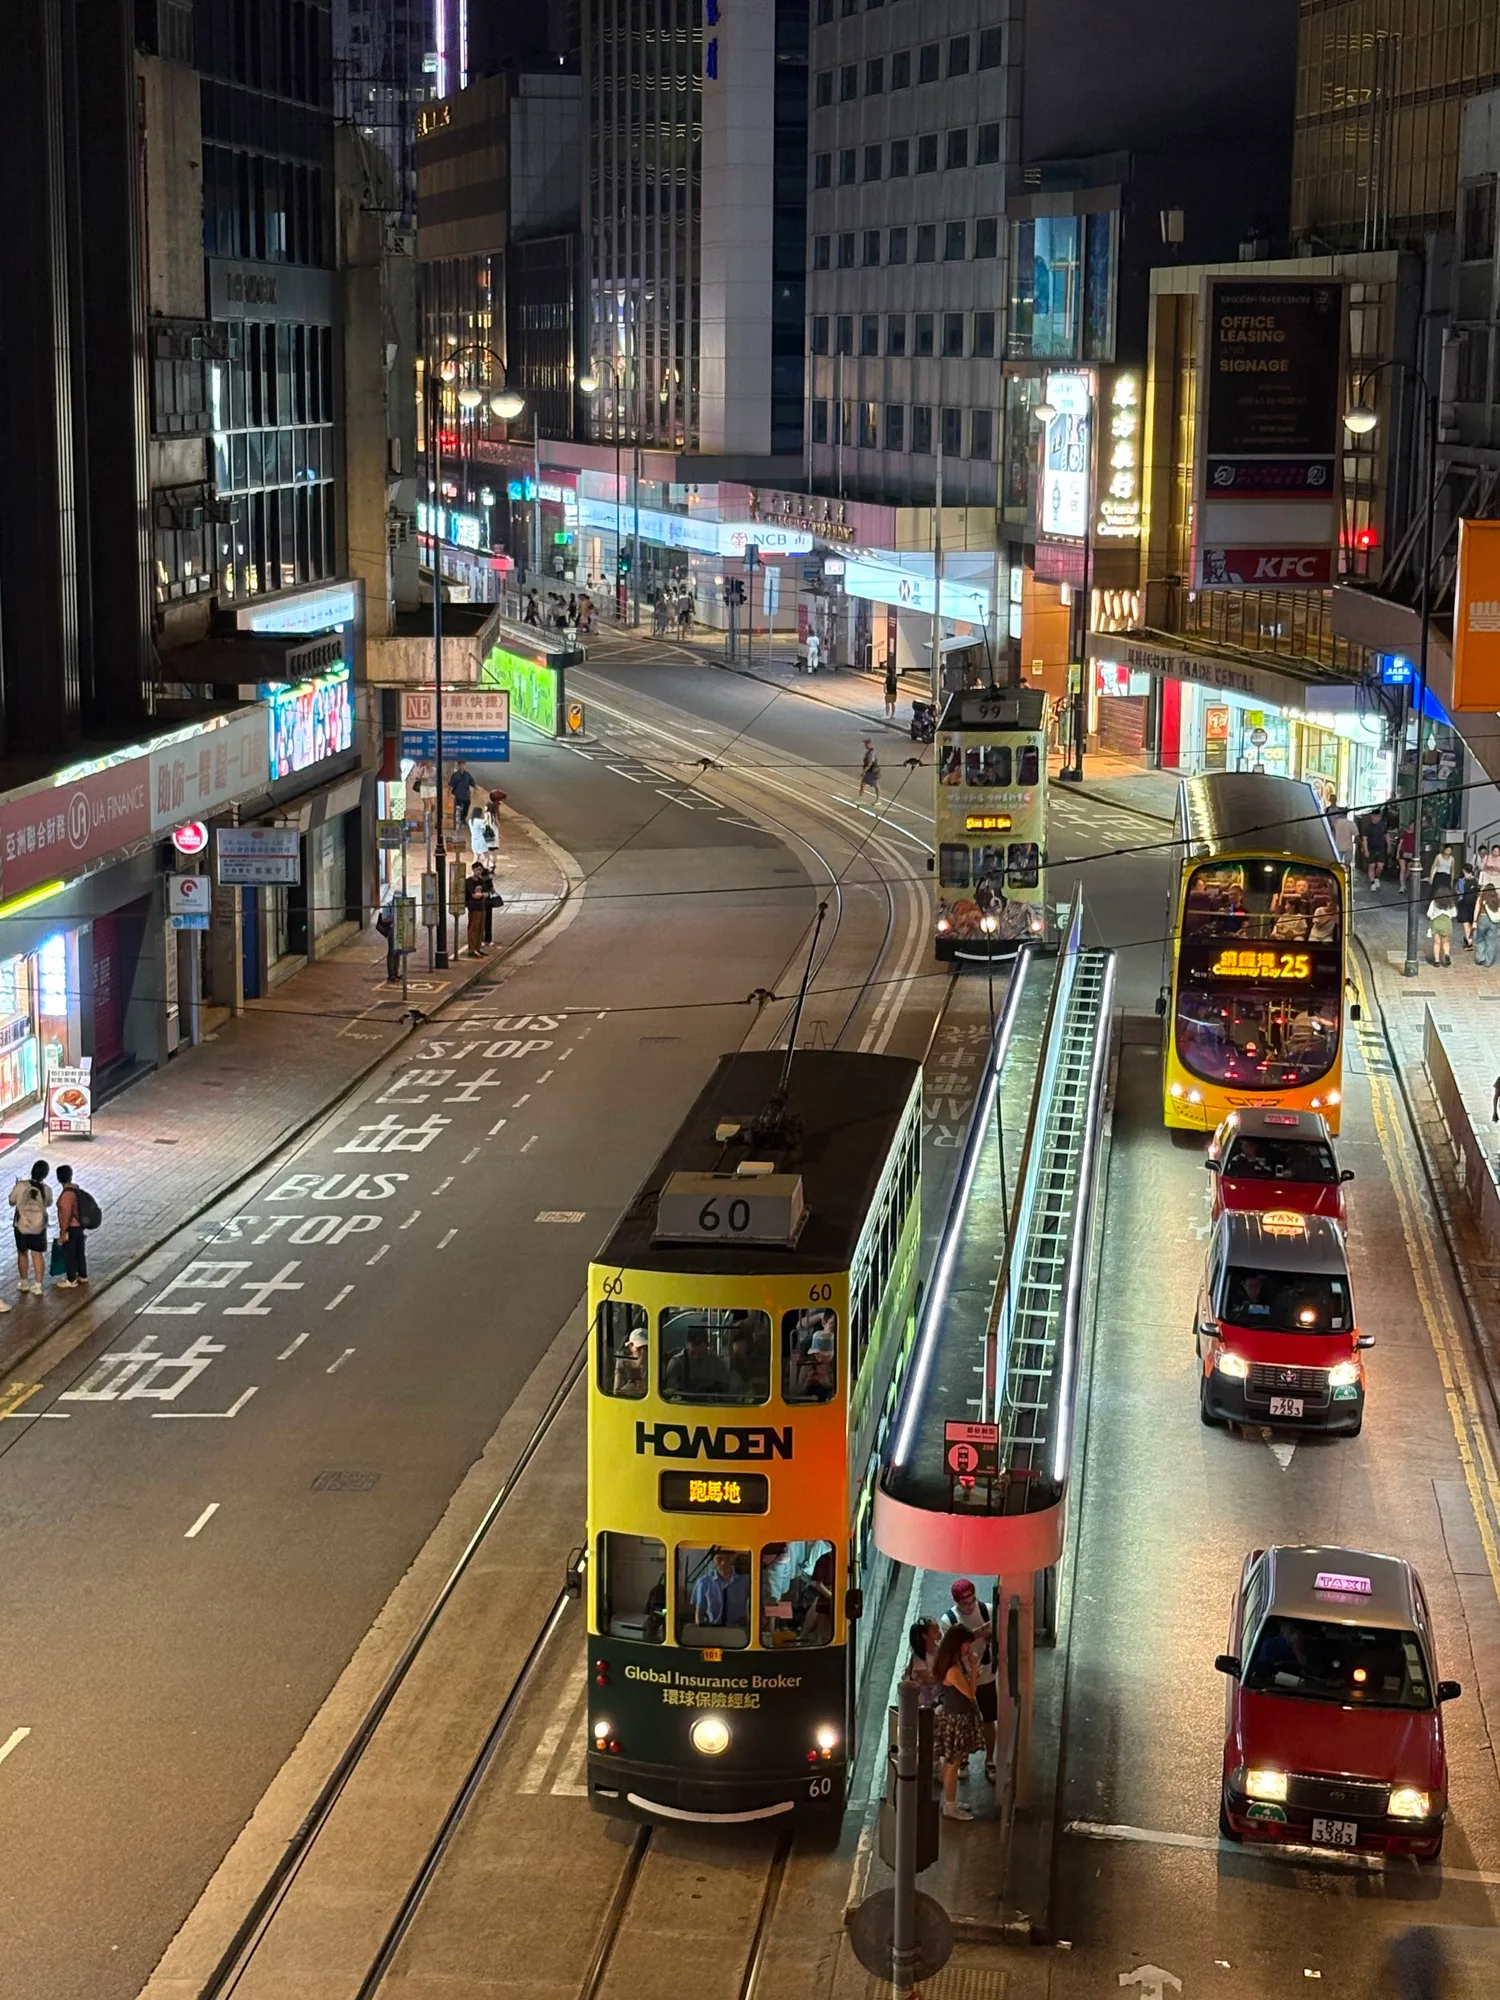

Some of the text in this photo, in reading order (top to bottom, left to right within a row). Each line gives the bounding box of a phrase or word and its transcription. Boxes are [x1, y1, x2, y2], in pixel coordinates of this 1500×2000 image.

[1221, 316, 1275, 328] OFFICE
[1220, 330, 1285, 342] LEASING
[1220, 360, 1289, 371] SIGNAGE
[754, 534, 787, 546] NCB
[1254, 557, 1317, 578] KFC
[1128, 648, 1175, 673] UNICORN
[1177, 658, 1213, 680] TRADE
[407, 696, 430, 719] NE
[979, 704, 1001, 719] 99
[1026, 735, 1037, 744] 99
[91, 784, 145, 827] UA FINANCE
[1212, 964, 1260, 977] Causeway
[1261, 966, 1281, 978] Bay
[1281, 954, 1309, 978] 25
[455, 1013, 567, 1032] BUS
[416, 1040, 554, 1060] STOP
[375, 1069, 501, 1104] 巴士
[334, 1114, 452, 1153] 站
[264, 1173, 410, 1201] BUS
[699, 1198, 751, 1232] 60
[1268, 1214, 1299, 1223] TAXI
[199, 1215, 383, 1244] STOP
[135, 1261, 305, 1316] 巴士
[602, 1276, 624, 1295] 60
[809, 1283, 832, 1302] 60
[58, 1335, 227, 1401] 站
[636, 1421, 793, 1460] HOWDEN
[689, 1479, 741, 1505] 跑馬地
[1319, 1576, 1368, 1591] TAXI
[624, 1665, 802, 1688] Global Insurance Broker
[662, 1688, 761, 1710] 環球保險經紀
[808, 1778, 831, 1797] 60
[1325, 1820, 1345, 1832] RJ
[1315, 1829, 1353, 1845] 3383
